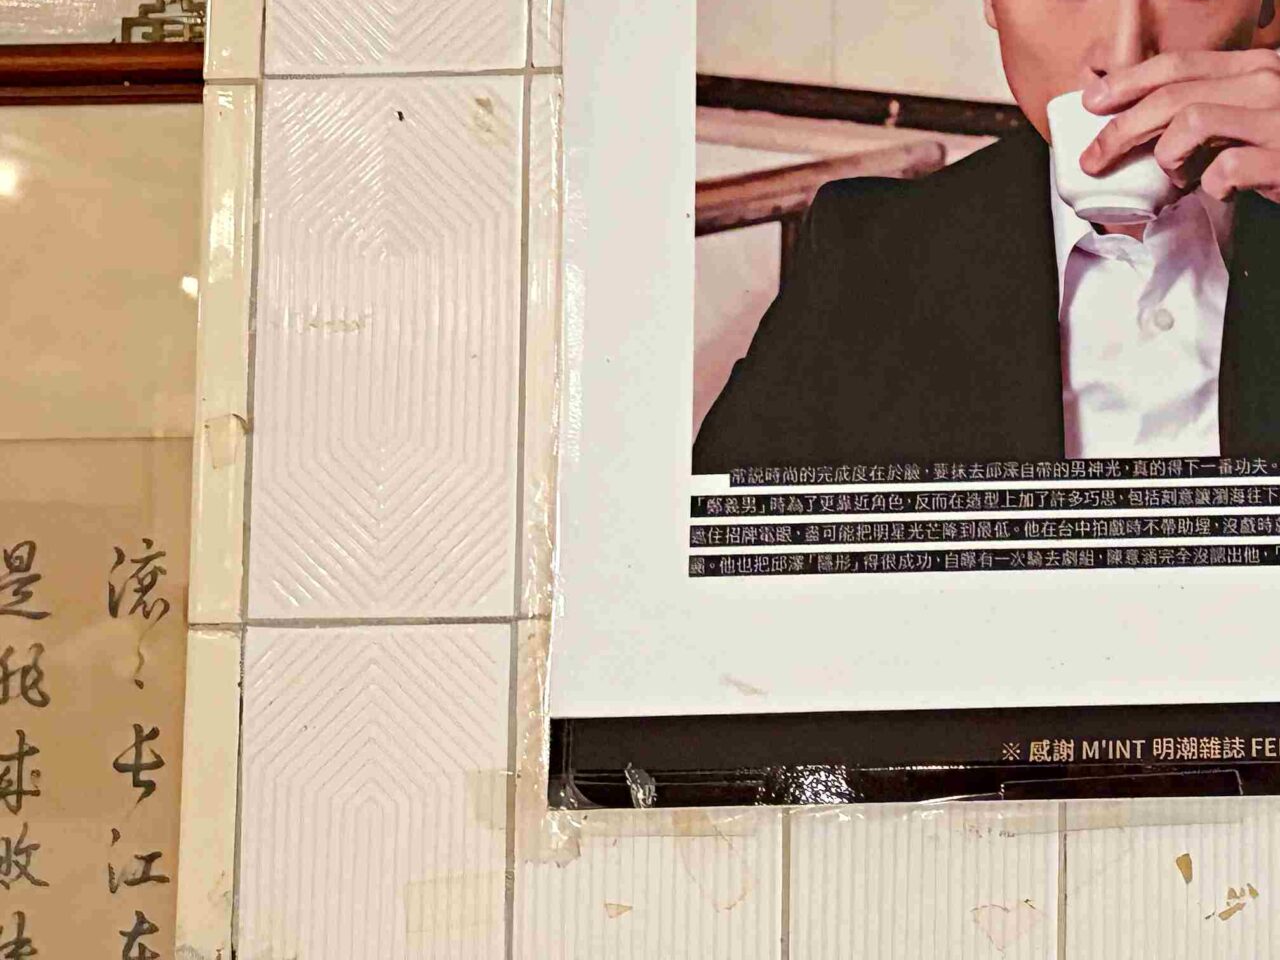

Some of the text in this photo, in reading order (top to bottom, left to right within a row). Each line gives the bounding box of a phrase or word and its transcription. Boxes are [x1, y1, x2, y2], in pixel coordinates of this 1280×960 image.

[1028, 738, 1075, 762] 感謝
[1082, 739, 1146, 760] M'INT
[1152, 736, 1246, 760] 明潮雜誌
